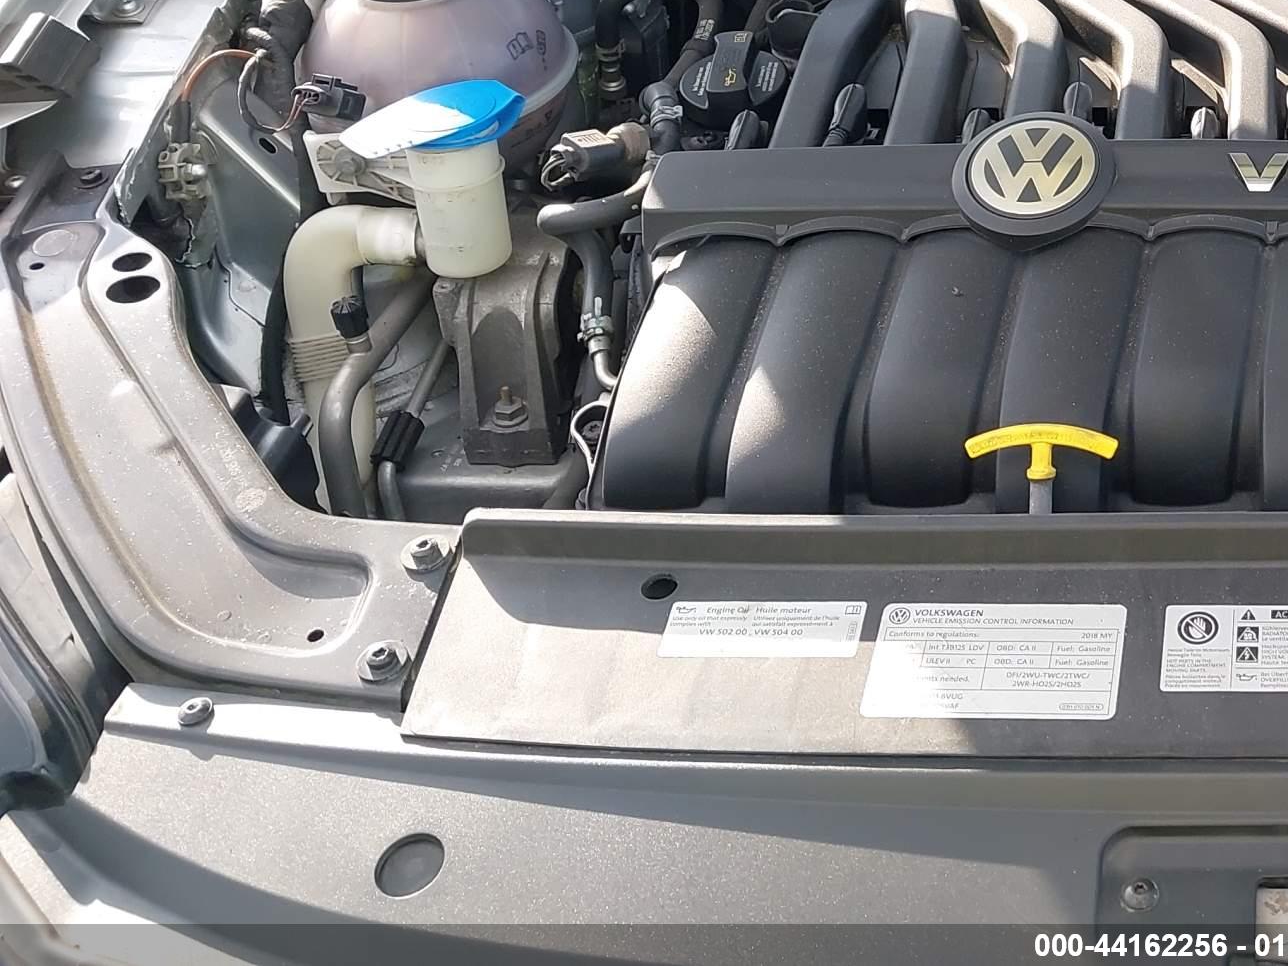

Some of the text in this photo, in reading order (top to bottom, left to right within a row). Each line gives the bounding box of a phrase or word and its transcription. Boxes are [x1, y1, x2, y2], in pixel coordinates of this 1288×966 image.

[707, 605, 750, 615] Engine Oil
[914, 609, 984, 617] VOLKSWAGEN
[996, 644, 1016, 652] OBD:
[1078, 645, 1111, 653] Gasoline
[941, 675, 970, 683] needed.
